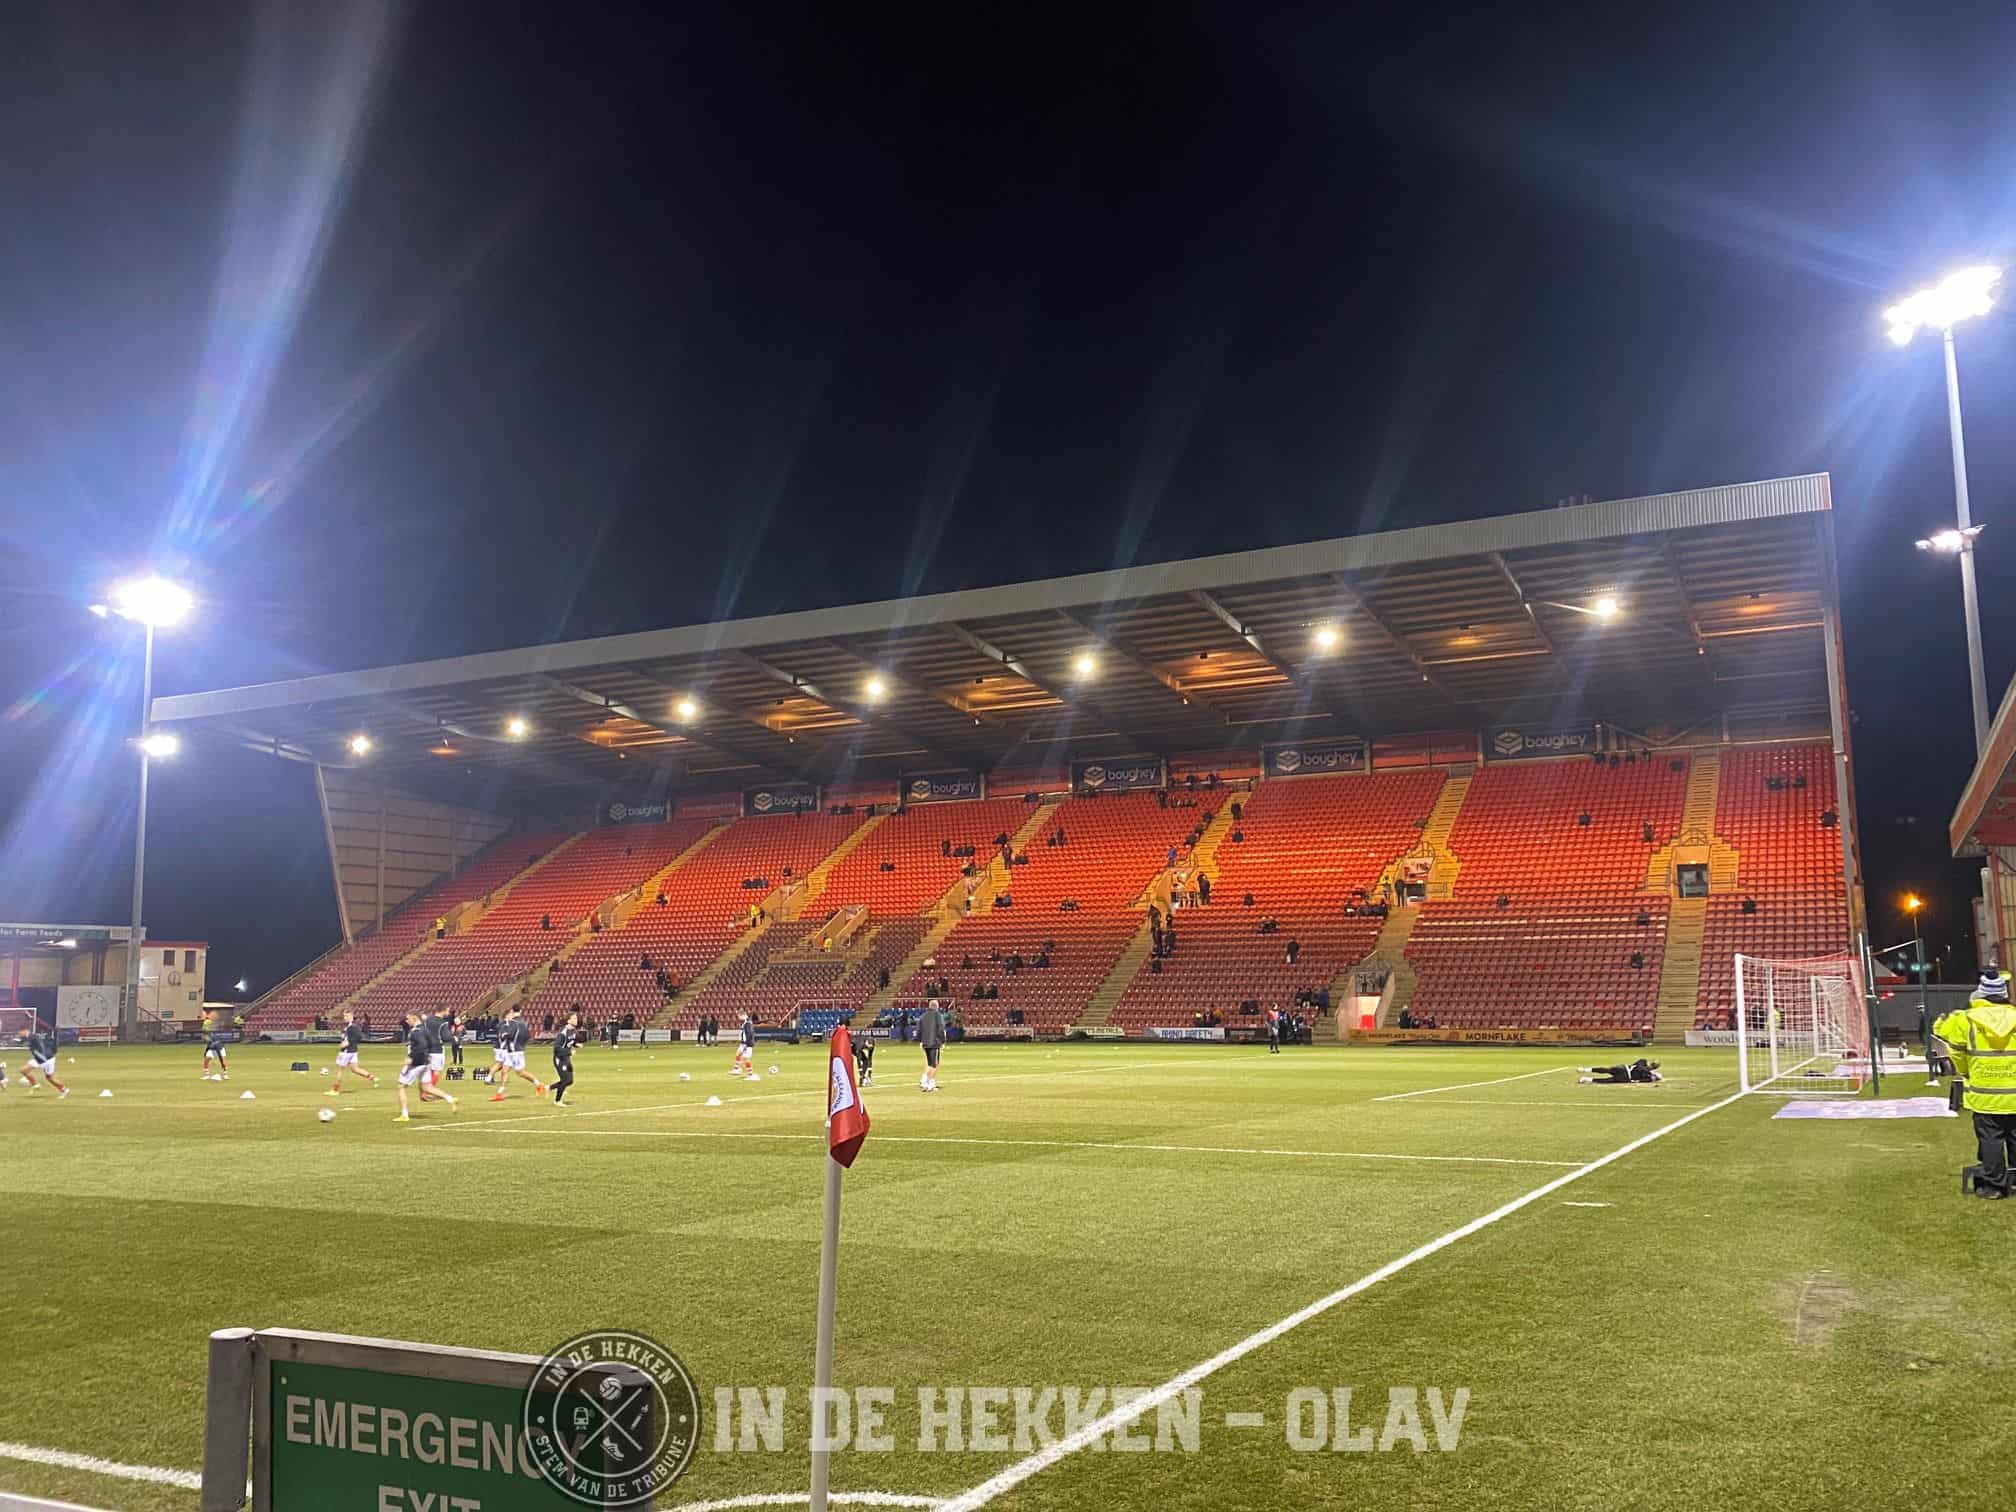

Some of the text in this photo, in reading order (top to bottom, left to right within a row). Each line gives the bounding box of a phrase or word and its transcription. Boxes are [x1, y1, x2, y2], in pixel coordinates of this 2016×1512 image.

[1525, 734, 1586, 750] boughey
[1303, 751, 1357, 767] boughey
[1107, 768, 1156, 782] boughey
[931, 781, 976, 795] boughey
[1465, 1032, 1527, 1041] MORNFLAKE
